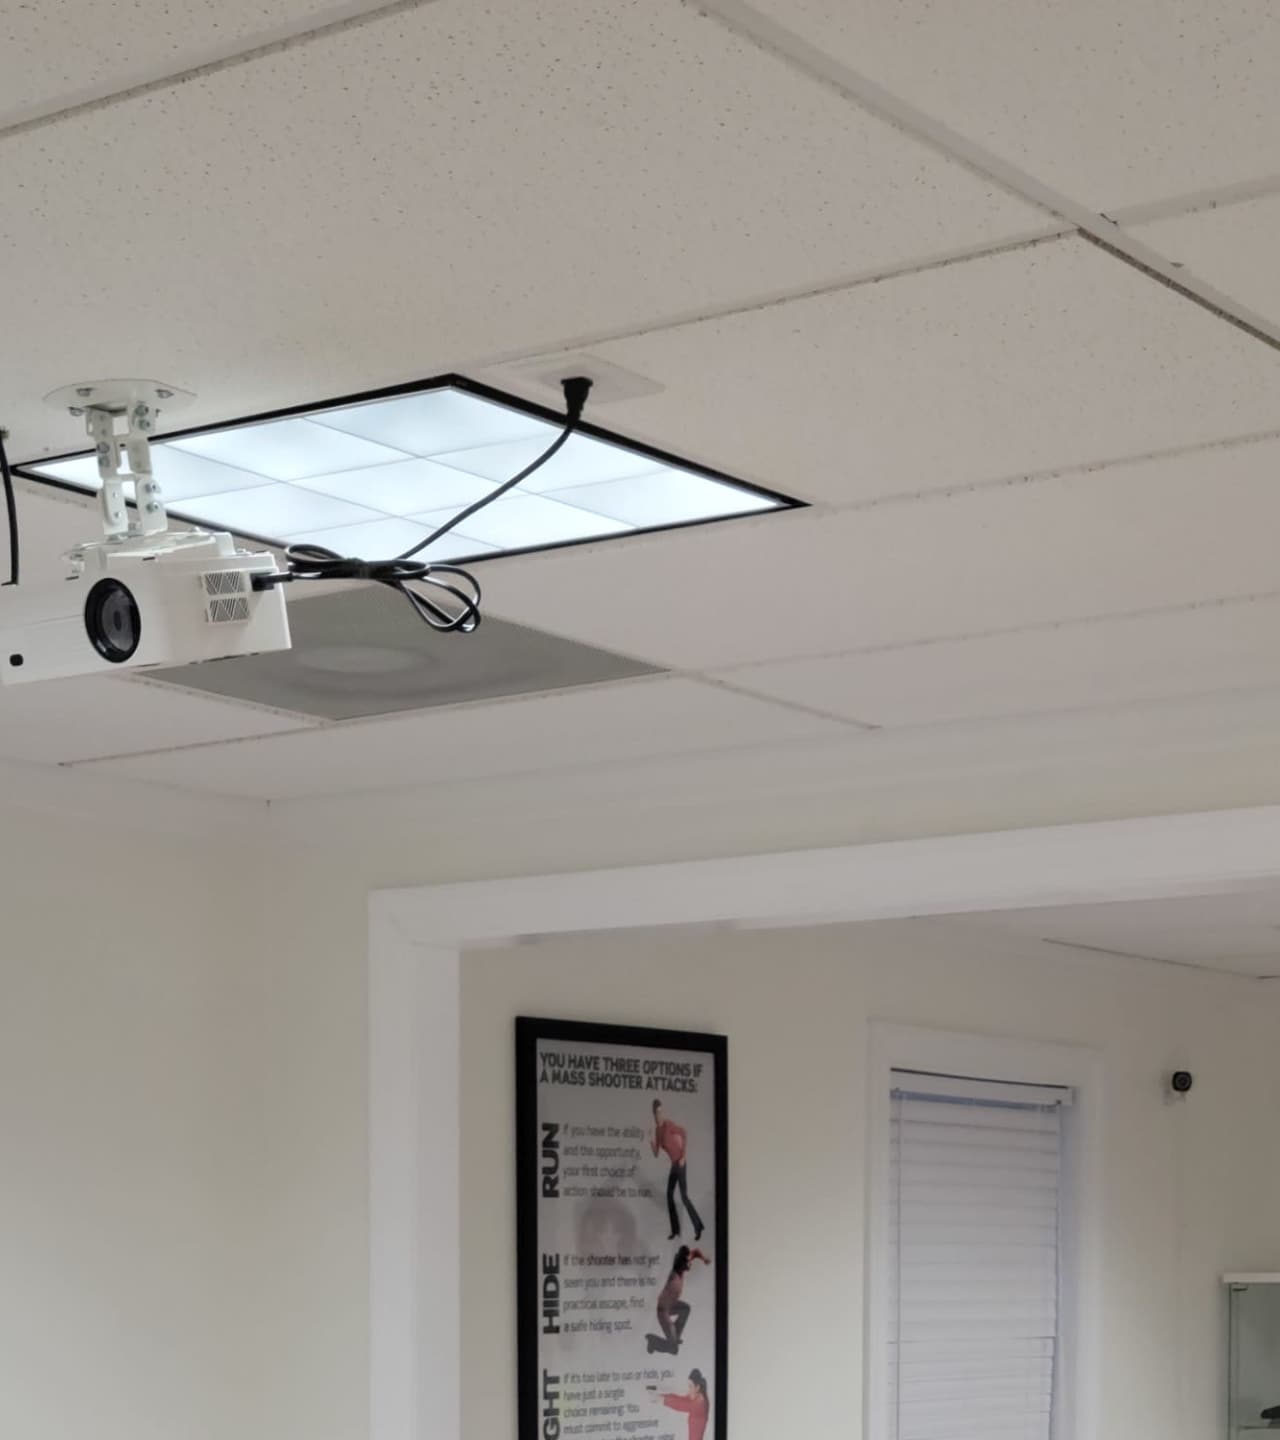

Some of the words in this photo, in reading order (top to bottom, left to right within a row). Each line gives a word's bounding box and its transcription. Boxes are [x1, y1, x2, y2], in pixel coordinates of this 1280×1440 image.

[540, 1052, 565, 1068] YOU
[570, 1055, 600, 1071] HAVE
[602, 1057, 640, 1073] THREE
[643, 1060, 691, 1077] OPTIONS
[693, 1064, 703, 1078] IF
[540, 1069, 549, 1083] A
[551, 1070, 585, 1086] MASS
[588, 1073, 642, 1089] SHOOTER
[646, 1076, 698, 1093] ATTACKS:
[542, 1122, 560, 1198] RUN
[543, 1254, 560, 1333] HIDE
